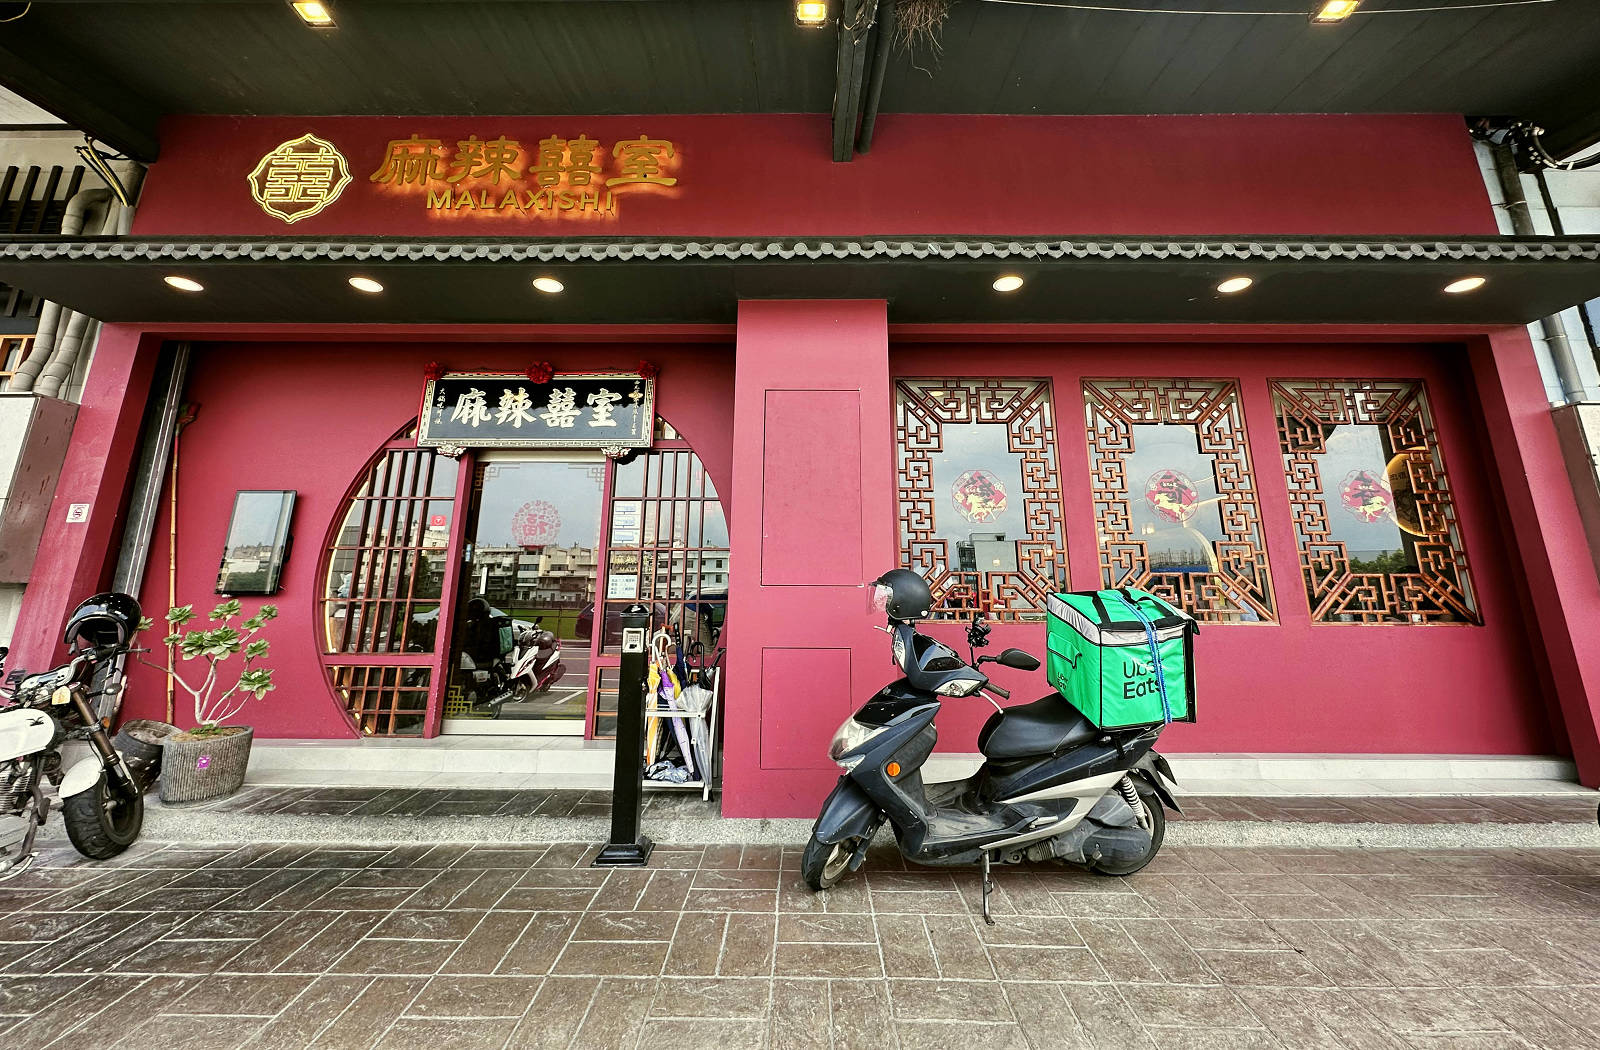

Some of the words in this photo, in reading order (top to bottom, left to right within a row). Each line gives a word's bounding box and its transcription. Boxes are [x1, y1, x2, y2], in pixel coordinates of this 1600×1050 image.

[369, 134, 678, 187] 麻辣囍室
[426, 190, 614, 211] MALAXISHI
[450, 387, 623, 429] 麻辣囍室
